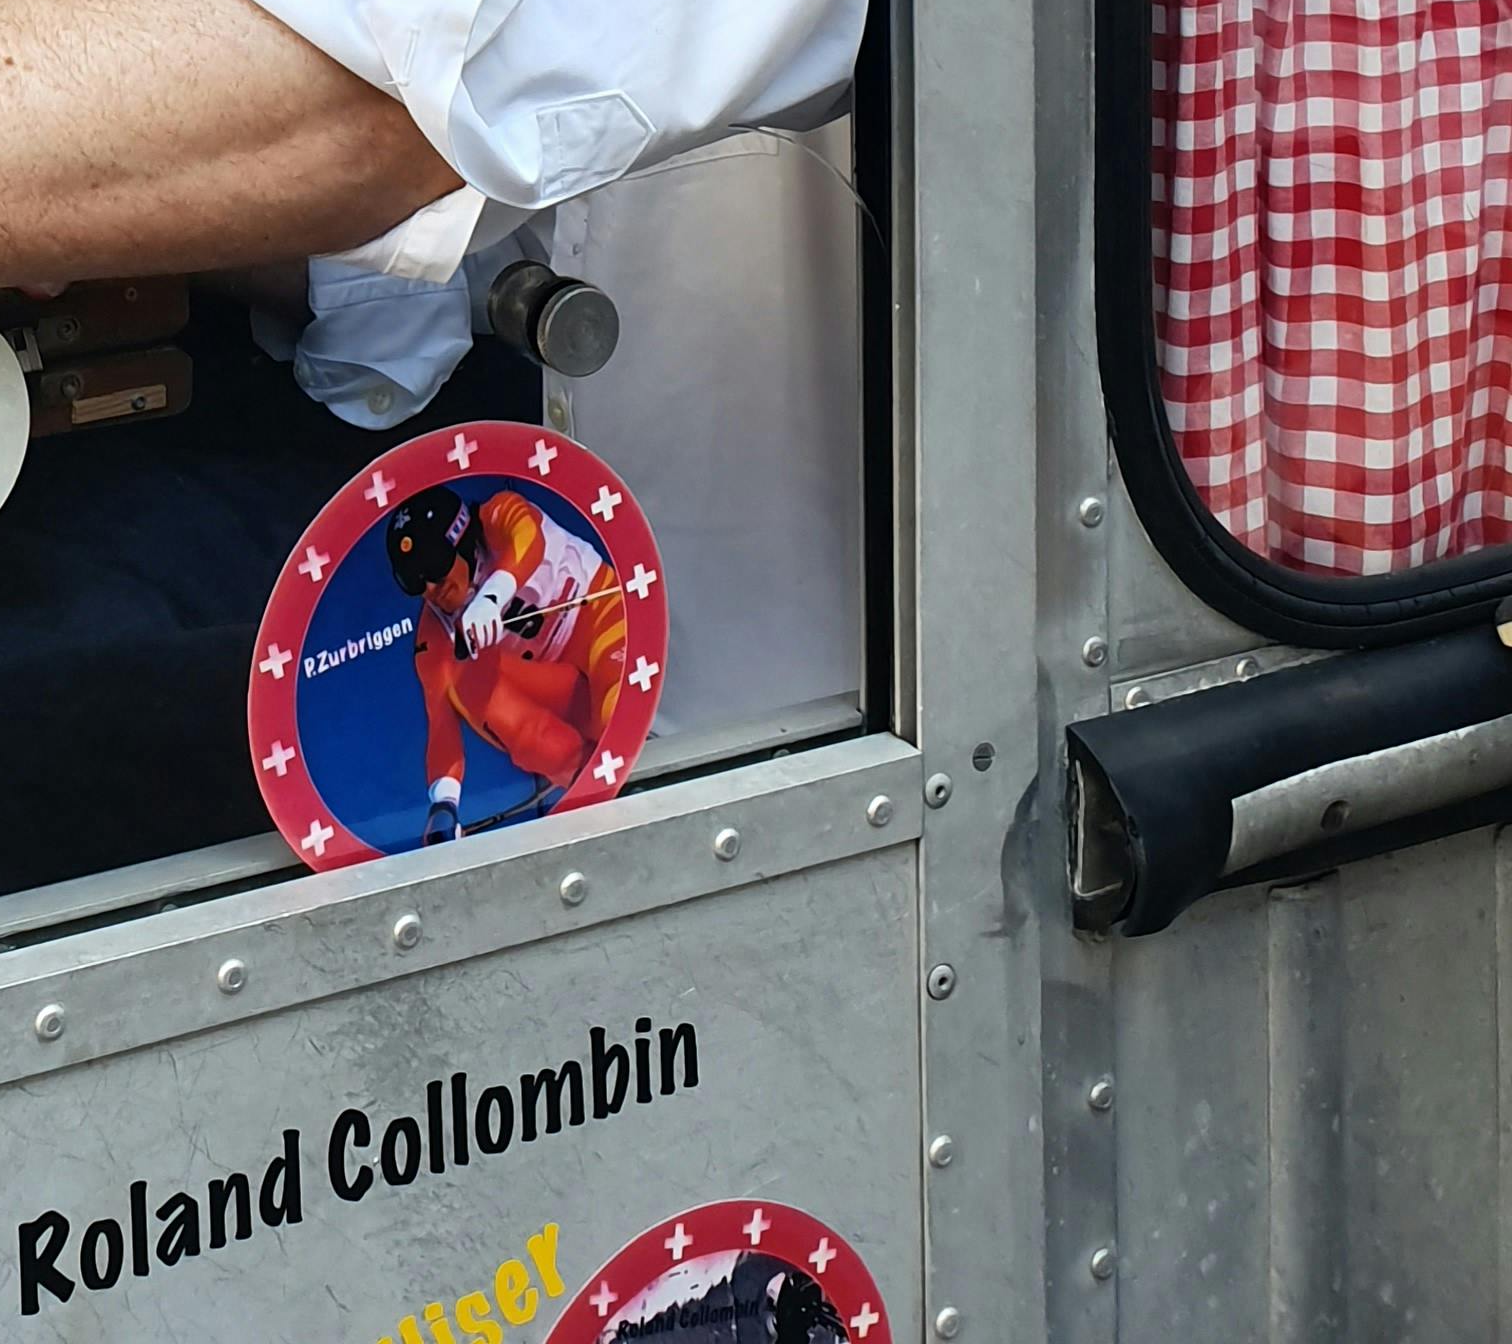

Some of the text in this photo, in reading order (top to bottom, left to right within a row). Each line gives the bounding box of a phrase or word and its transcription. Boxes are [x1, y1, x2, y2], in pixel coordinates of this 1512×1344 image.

[303, 617, 414, 679] P.Zurbriggen
[16, 1016, 701, 1316] Roland Collombin
[616, 1307, 677, 1341] Roland
